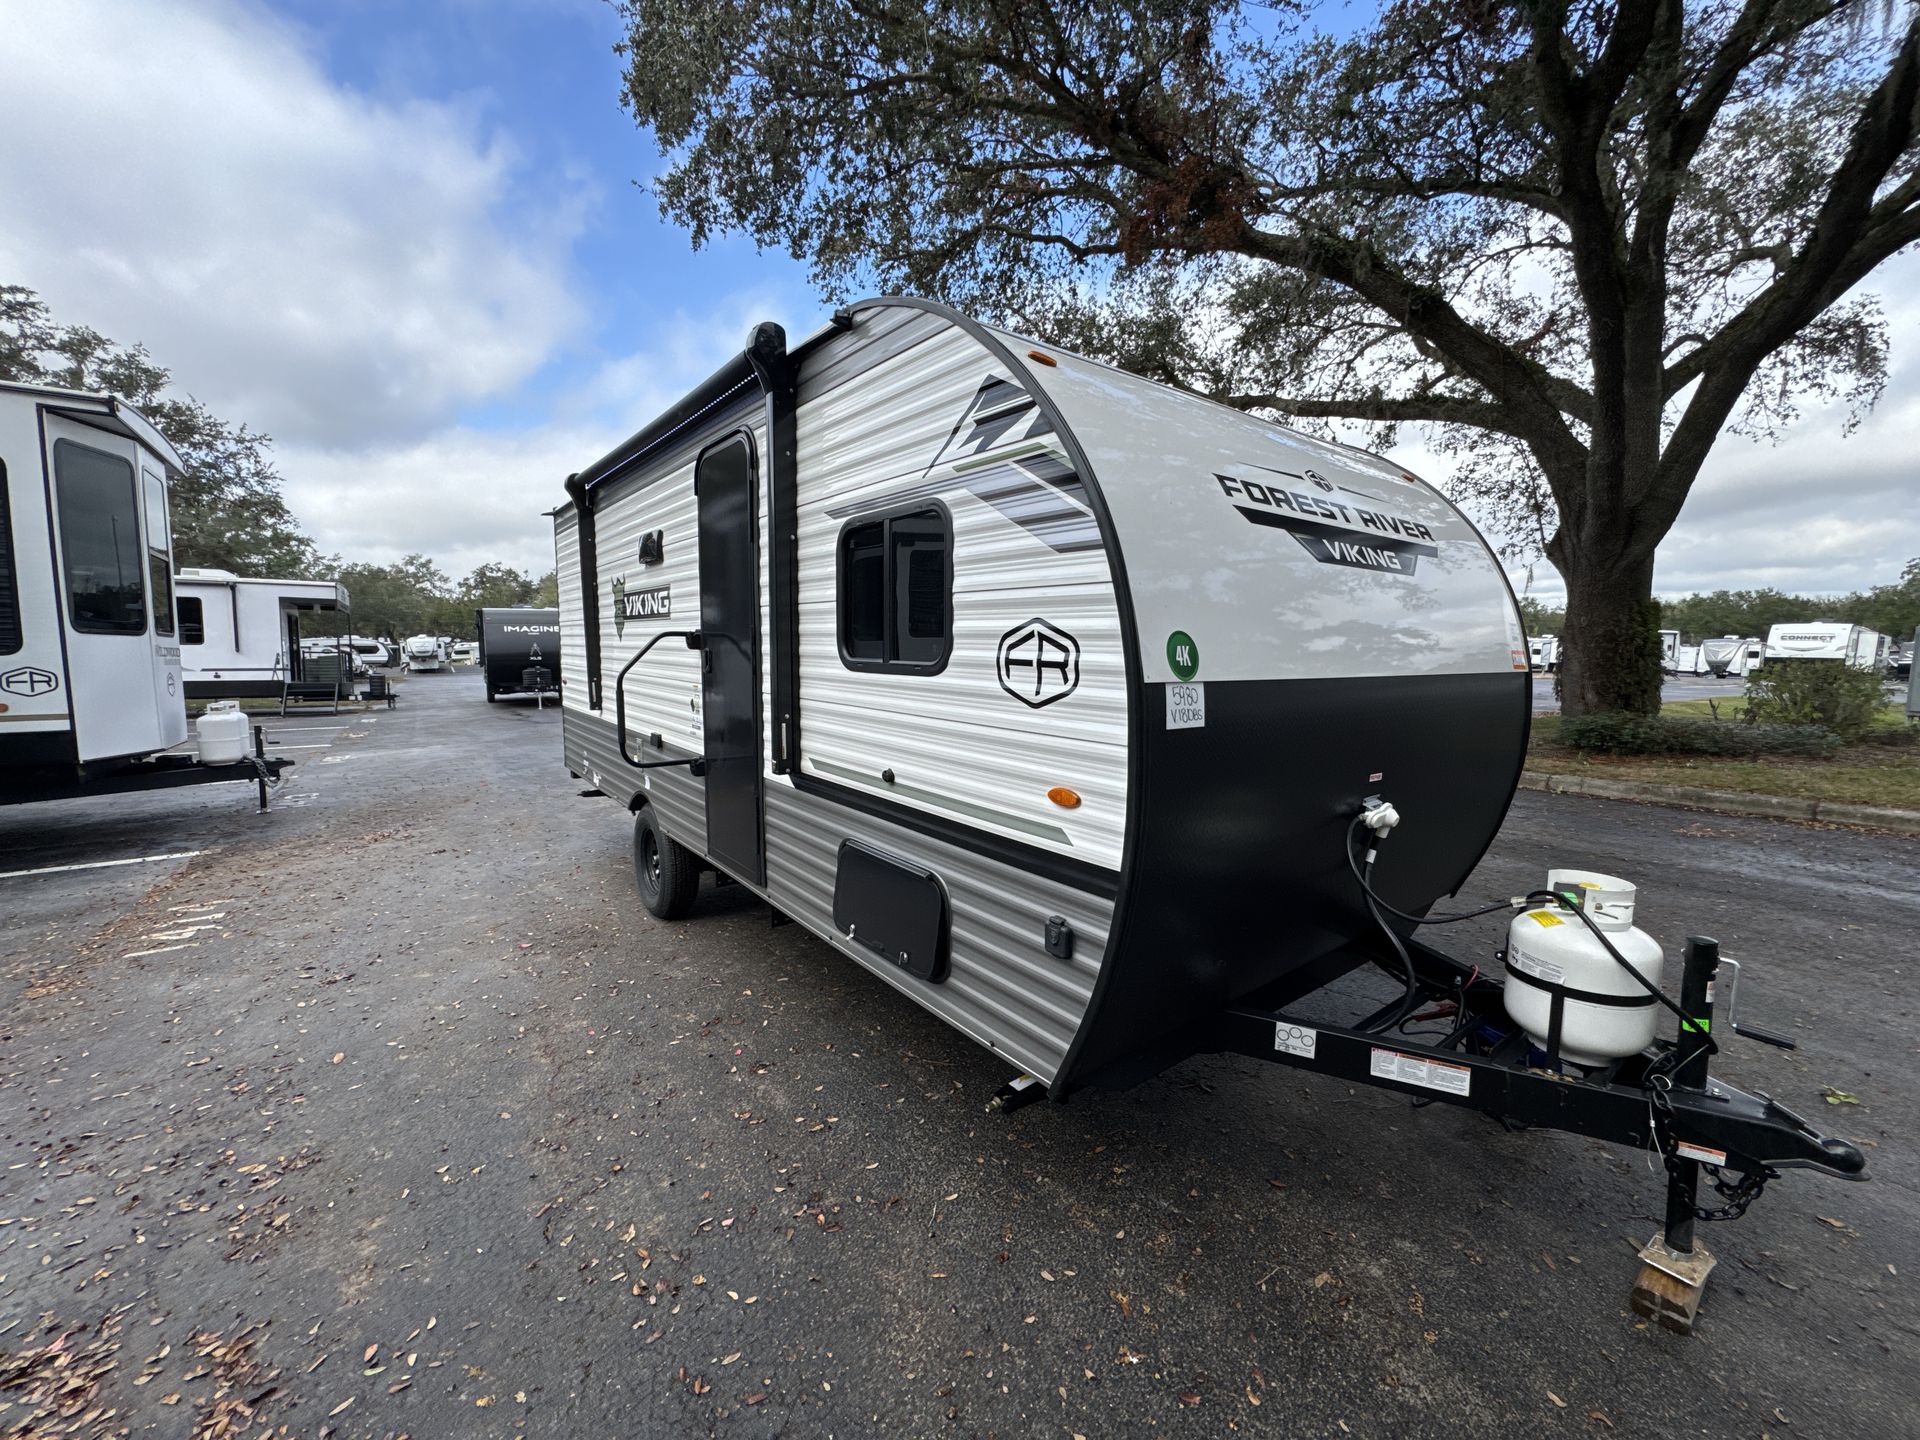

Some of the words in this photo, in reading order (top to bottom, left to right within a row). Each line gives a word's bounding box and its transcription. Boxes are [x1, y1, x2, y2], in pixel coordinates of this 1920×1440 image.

[1212, 472, 1352, 524] FOREST
[1353, 506, 1436, 542] RIVER
[1322, 538, 1402, 570] VIKING
[624, 590, 670, 617] VIKING
[503, 625, 560, 633] IMAGINE
[1176, 645, 1192, 667] 4K
